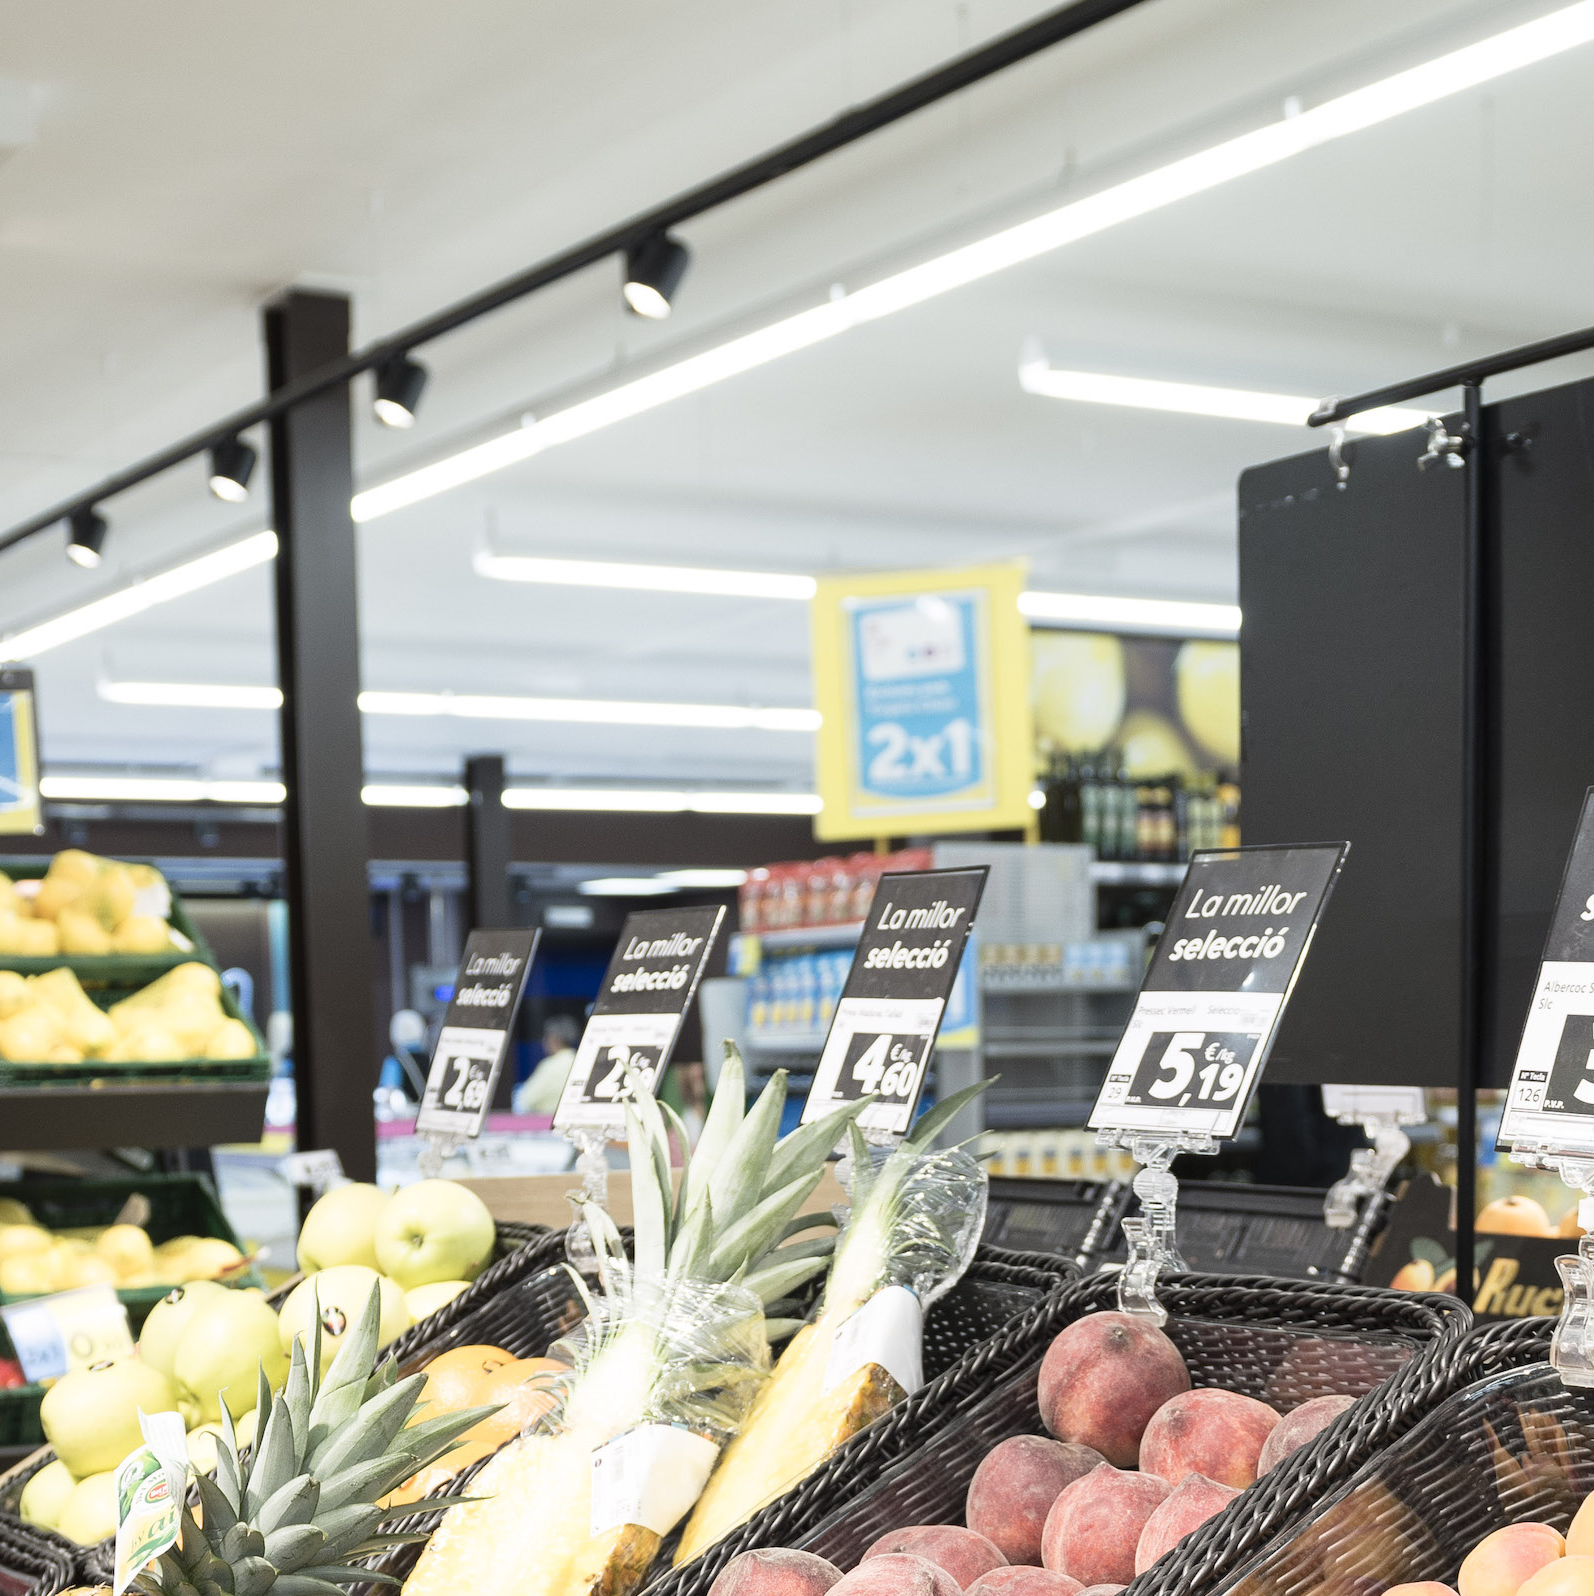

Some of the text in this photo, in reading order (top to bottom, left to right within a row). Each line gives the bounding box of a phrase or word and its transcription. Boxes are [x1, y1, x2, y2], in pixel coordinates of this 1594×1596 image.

[866, 717, 972, 783] 2x1
[877, 900, 966, 931] La millor
[1185, 884, 1308, 919] La millor
[622, 932, 704, 961] La millor
[863, 939, 952, 969] selecció
[1168, 926, 1290, 962] selecció
[465, 951, 523, 976] La millor
[610, 964, 691, 994] selecció
[1543, 981, 1588, 995] Albercoc
[456, 982, 514, 1008] selecció
[444, 1056, 488, 1112] 2,69
[1148, 1032, 1245, 1107] 5,19
[1517, 1088, 1540, 1103] 126
[147, 1504, 177, 1540] ai
